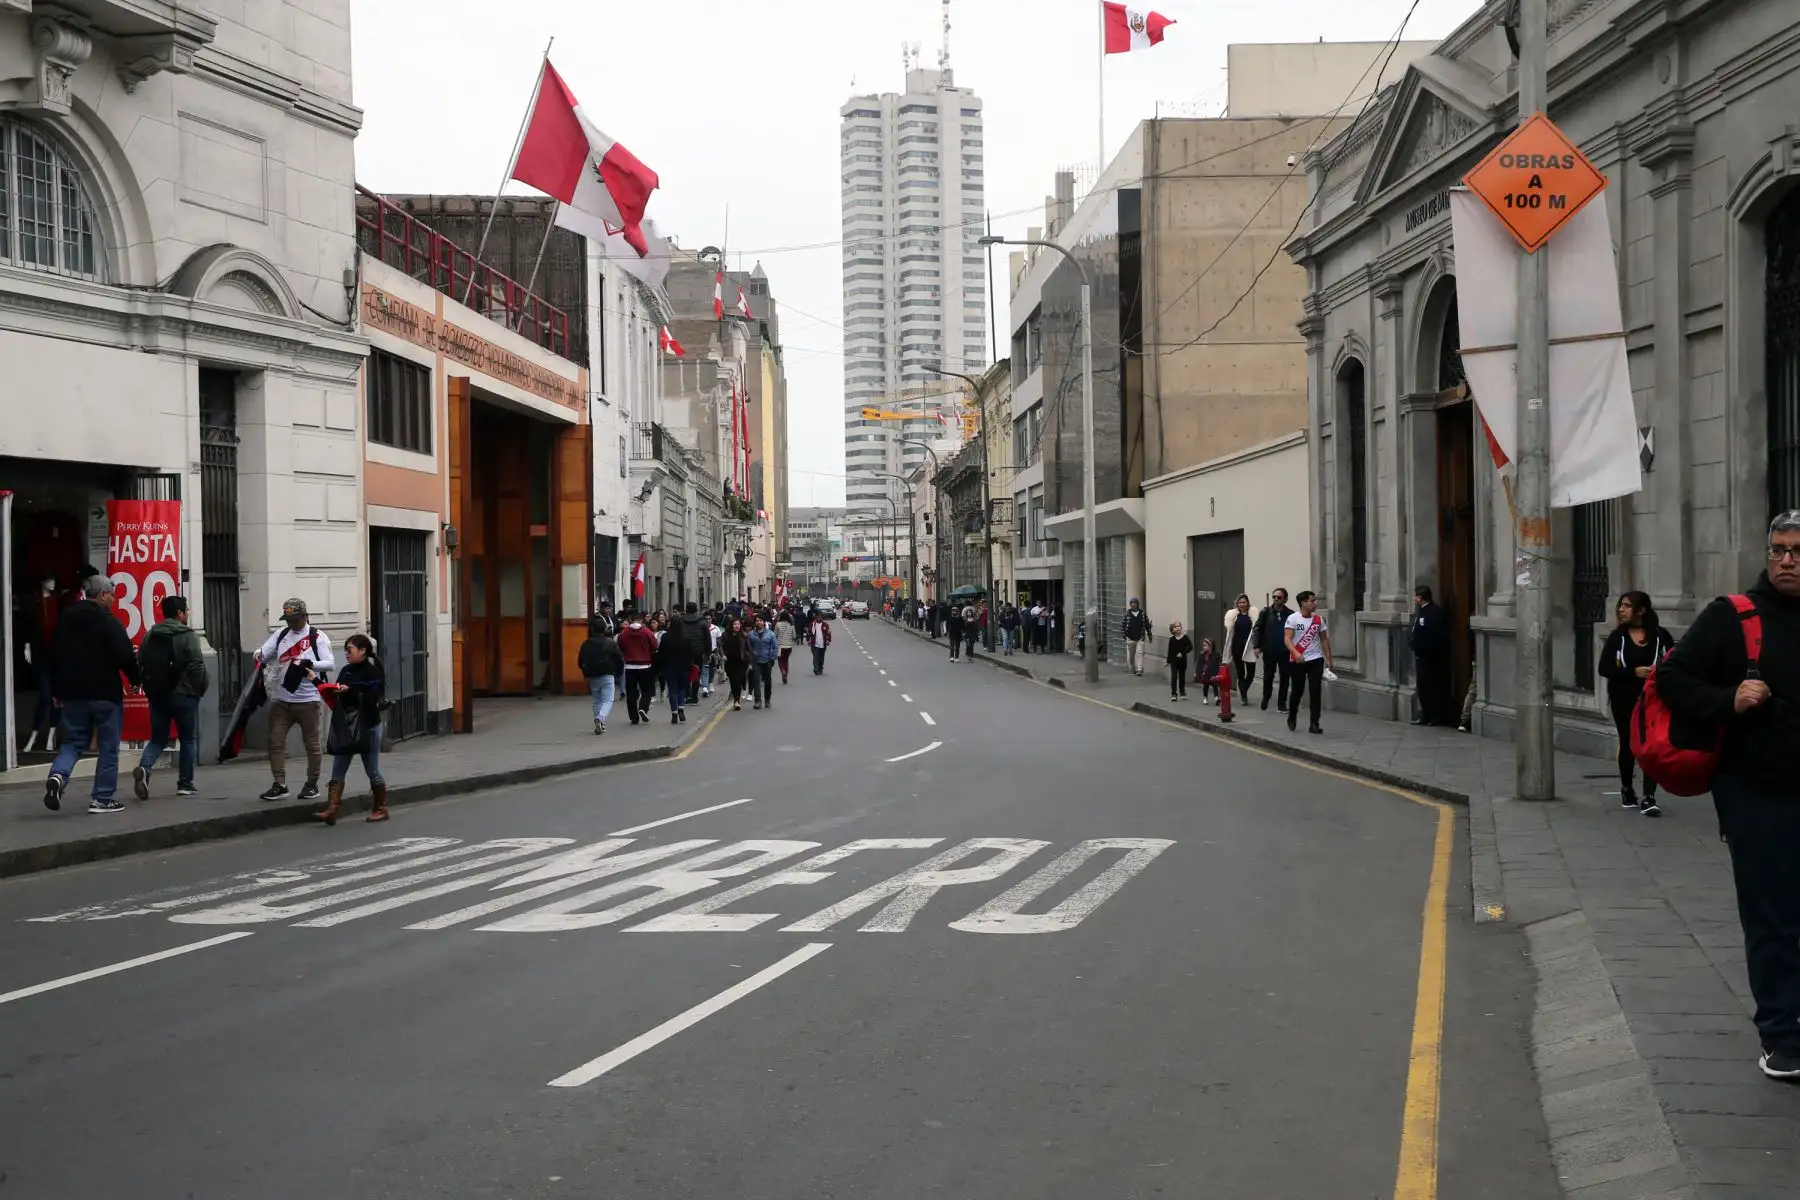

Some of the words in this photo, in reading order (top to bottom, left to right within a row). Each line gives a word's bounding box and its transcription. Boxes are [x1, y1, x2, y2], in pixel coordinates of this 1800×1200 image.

[1499, 154, 1575, 170] OBRAS
[1527, 174, 1543, 189] A
[1503, 194, 1541, 209] 100
[1548, 194, 1566, 209] M
[422, 316, 437, 347] DE
[107, 533, 177, 564] HASTA
[1296, 623, 1305, 631] 20
[22, 836, 1178, 934] BOMBERO
